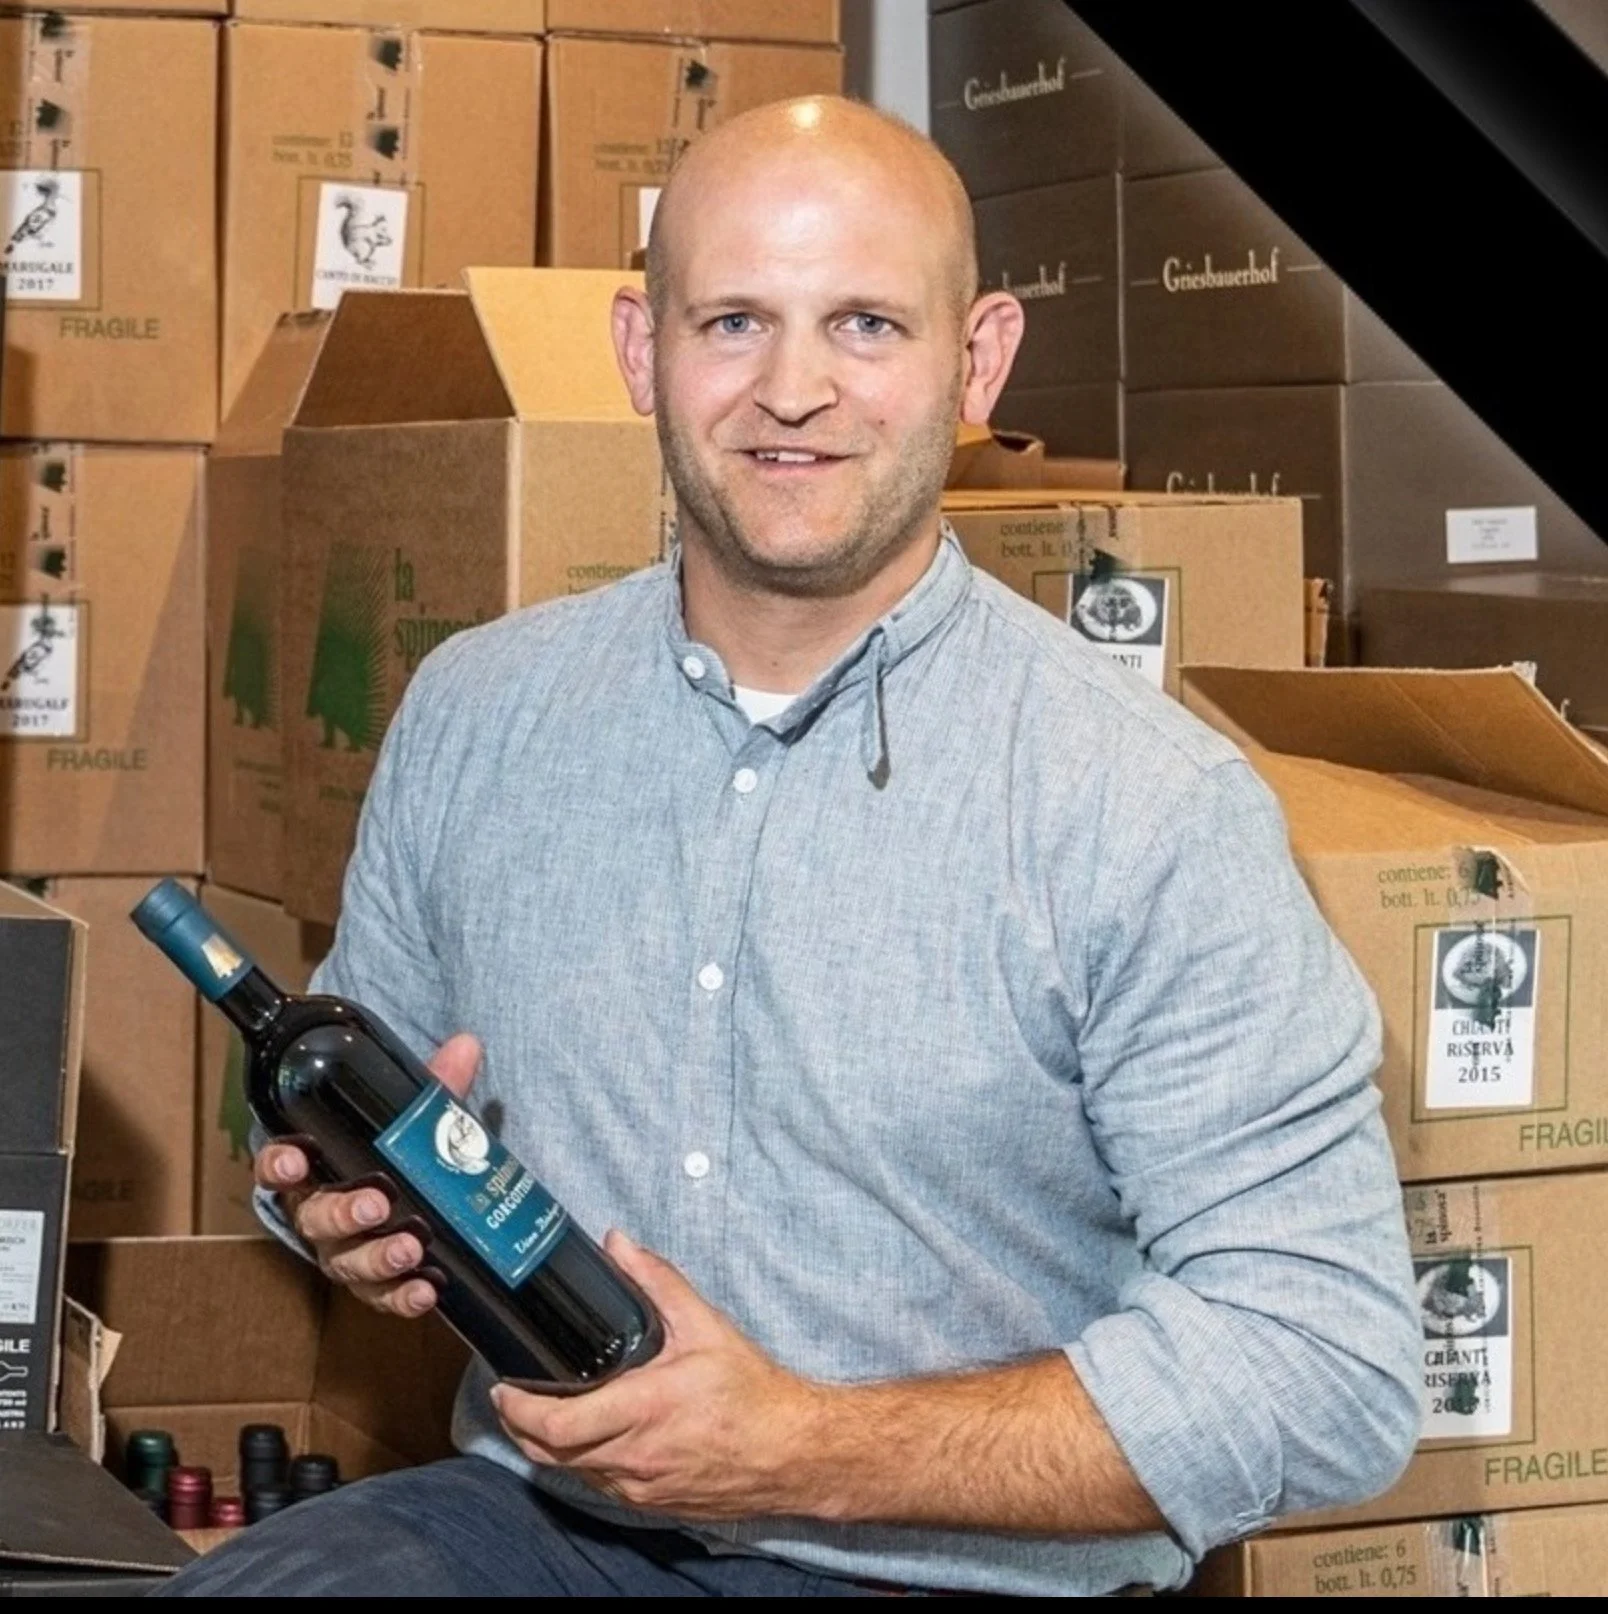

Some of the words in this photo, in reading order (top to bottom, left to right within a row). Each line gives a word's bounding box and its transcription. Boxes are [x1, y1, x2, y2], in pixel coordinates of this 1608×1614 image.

[964, 57, 1067, 111] Griesbauerhof
[18, 277, 55, 291] 2017
[1162, 246, 1281, 294] Griesbauerhof
[59, 315, 161, 341] FRAGILE
[394, 547, 415, 602] la
[46, 748, 148, 771] FRAGILE
[1457, 1065, 1502, 1084] 2015
[1483, 1447, 1608, 1486] FRAGILE
[1312, 1544, 1389, 1569] contiene:
[1395, 1538, 1406, 1559] 6
[1381, 1564, 1417, 1590] 0,75
